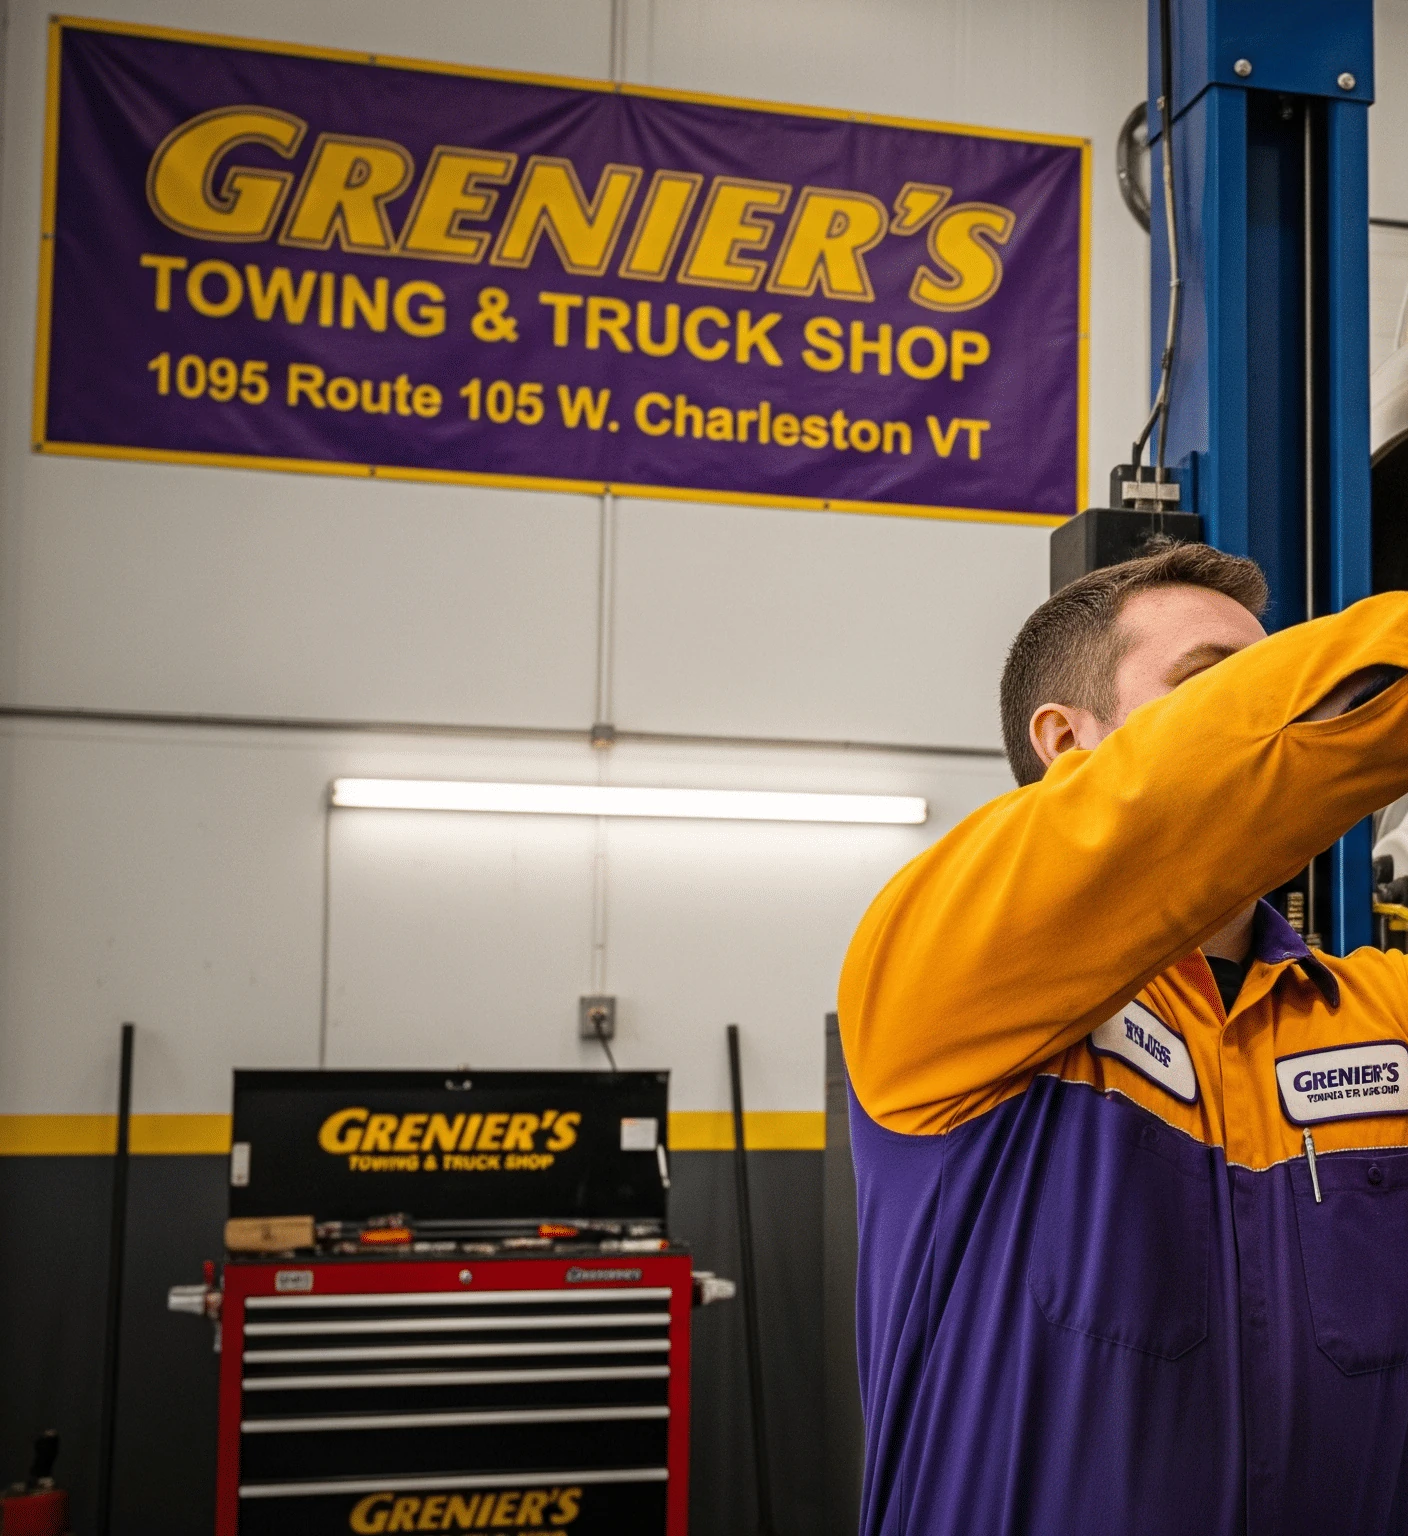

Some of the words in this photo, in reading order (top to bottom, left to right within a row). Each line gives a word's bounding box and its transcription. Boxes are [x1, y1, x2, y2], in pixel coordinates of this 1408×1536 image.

[146, 104, 1017, 313] GRENIER'S
[140, 254, 446, 337] TOWING
[470, 287, 518, 342] &
[538, 291, 783, 367] TRUCK
[802, 316, 991, 382] SHOP
[147, 353, 269, 404] 1095
[287, 363, 443, 418] Route
[458, 378, 545, 426] 105
[557, 384, 619, 432] W.
[634, 392, 912, 455] Charleston
[926, 415, 991, 461] VT
[1293, 1062, 1399, 1092] GRENIER'S
[318, 1107, 582, 1154] GRENIER'S
[443, 1154, 501, 1171] TRUCK
[505, 1154, 555, 1171] SHOP
[349, 1487, 583, 1535] GRENIER'S
